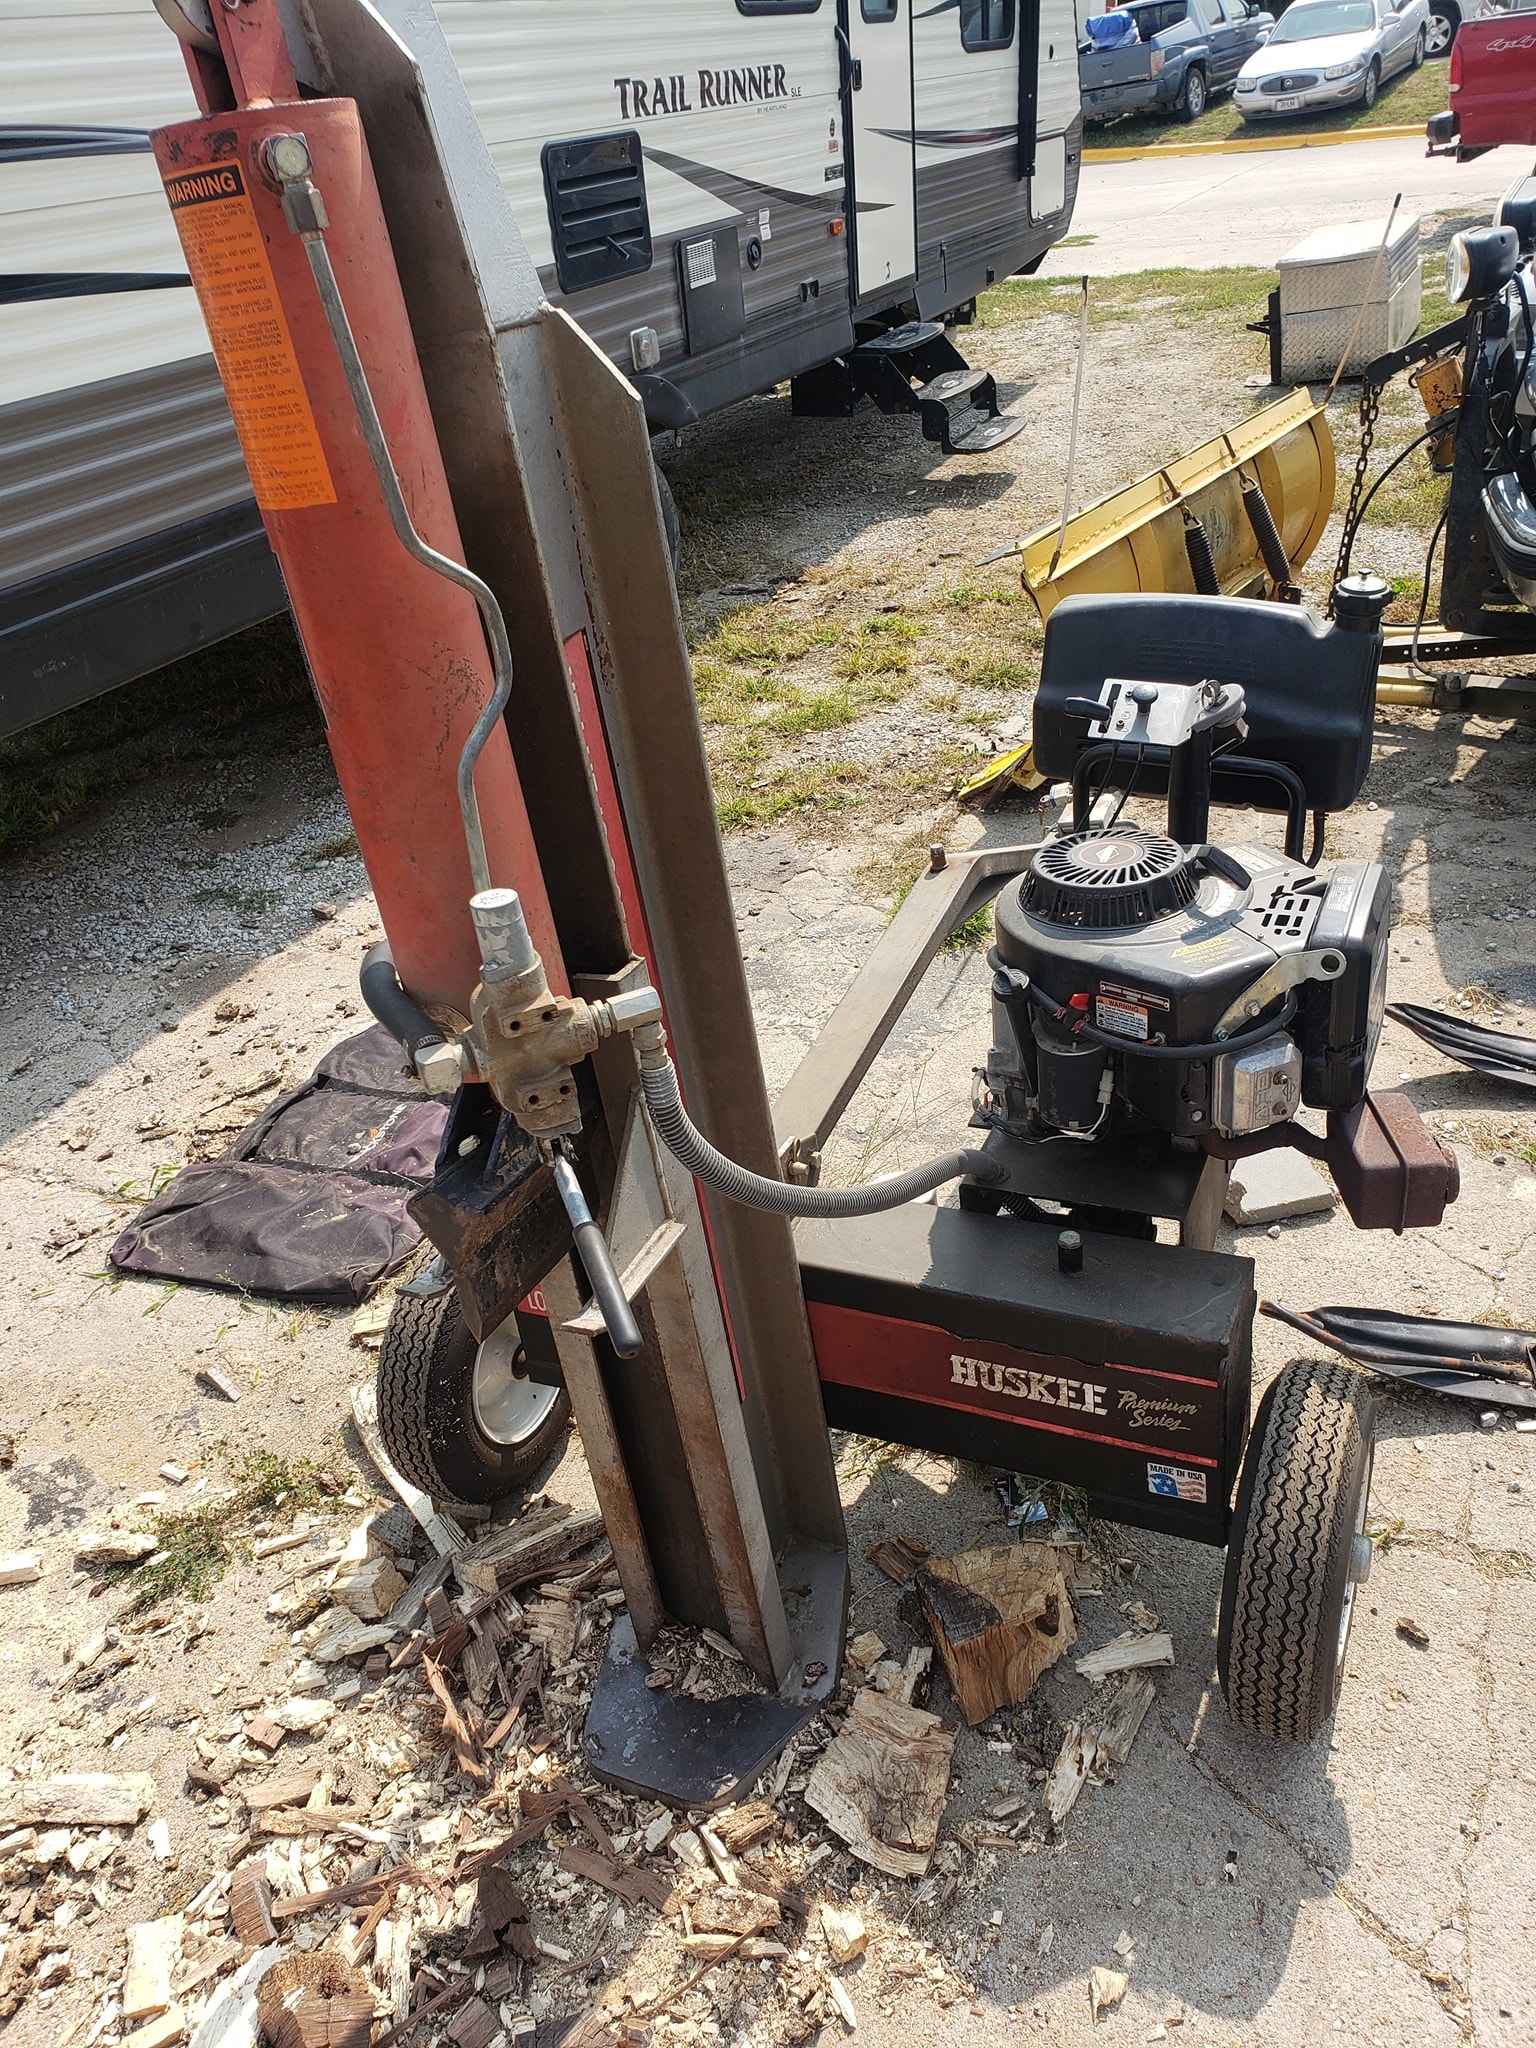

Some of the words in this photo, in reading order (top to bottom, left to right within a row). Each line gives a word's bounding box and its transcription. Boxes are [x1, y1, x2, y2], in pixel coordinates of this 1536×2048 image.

[613, 74, 691, 120] TRAIL
[697, 63, 788, 110] RUNNER
[791, 86, 801, 98] SLE
[167, 171, 236, 204] WARNING
[1108, 999, 1139, 1013] WARNING
[949, 1354, 1109, 1416] HUSKEE
[1117, 1389, 1197, 1416] Premium
[1128, 1409, 1191, 1431] Series
[1150, 1464, 1174, 1476] MADE
[1177, 1470, 1185, 1478] IN
[1187, 1471, 1203, 1482] USA
